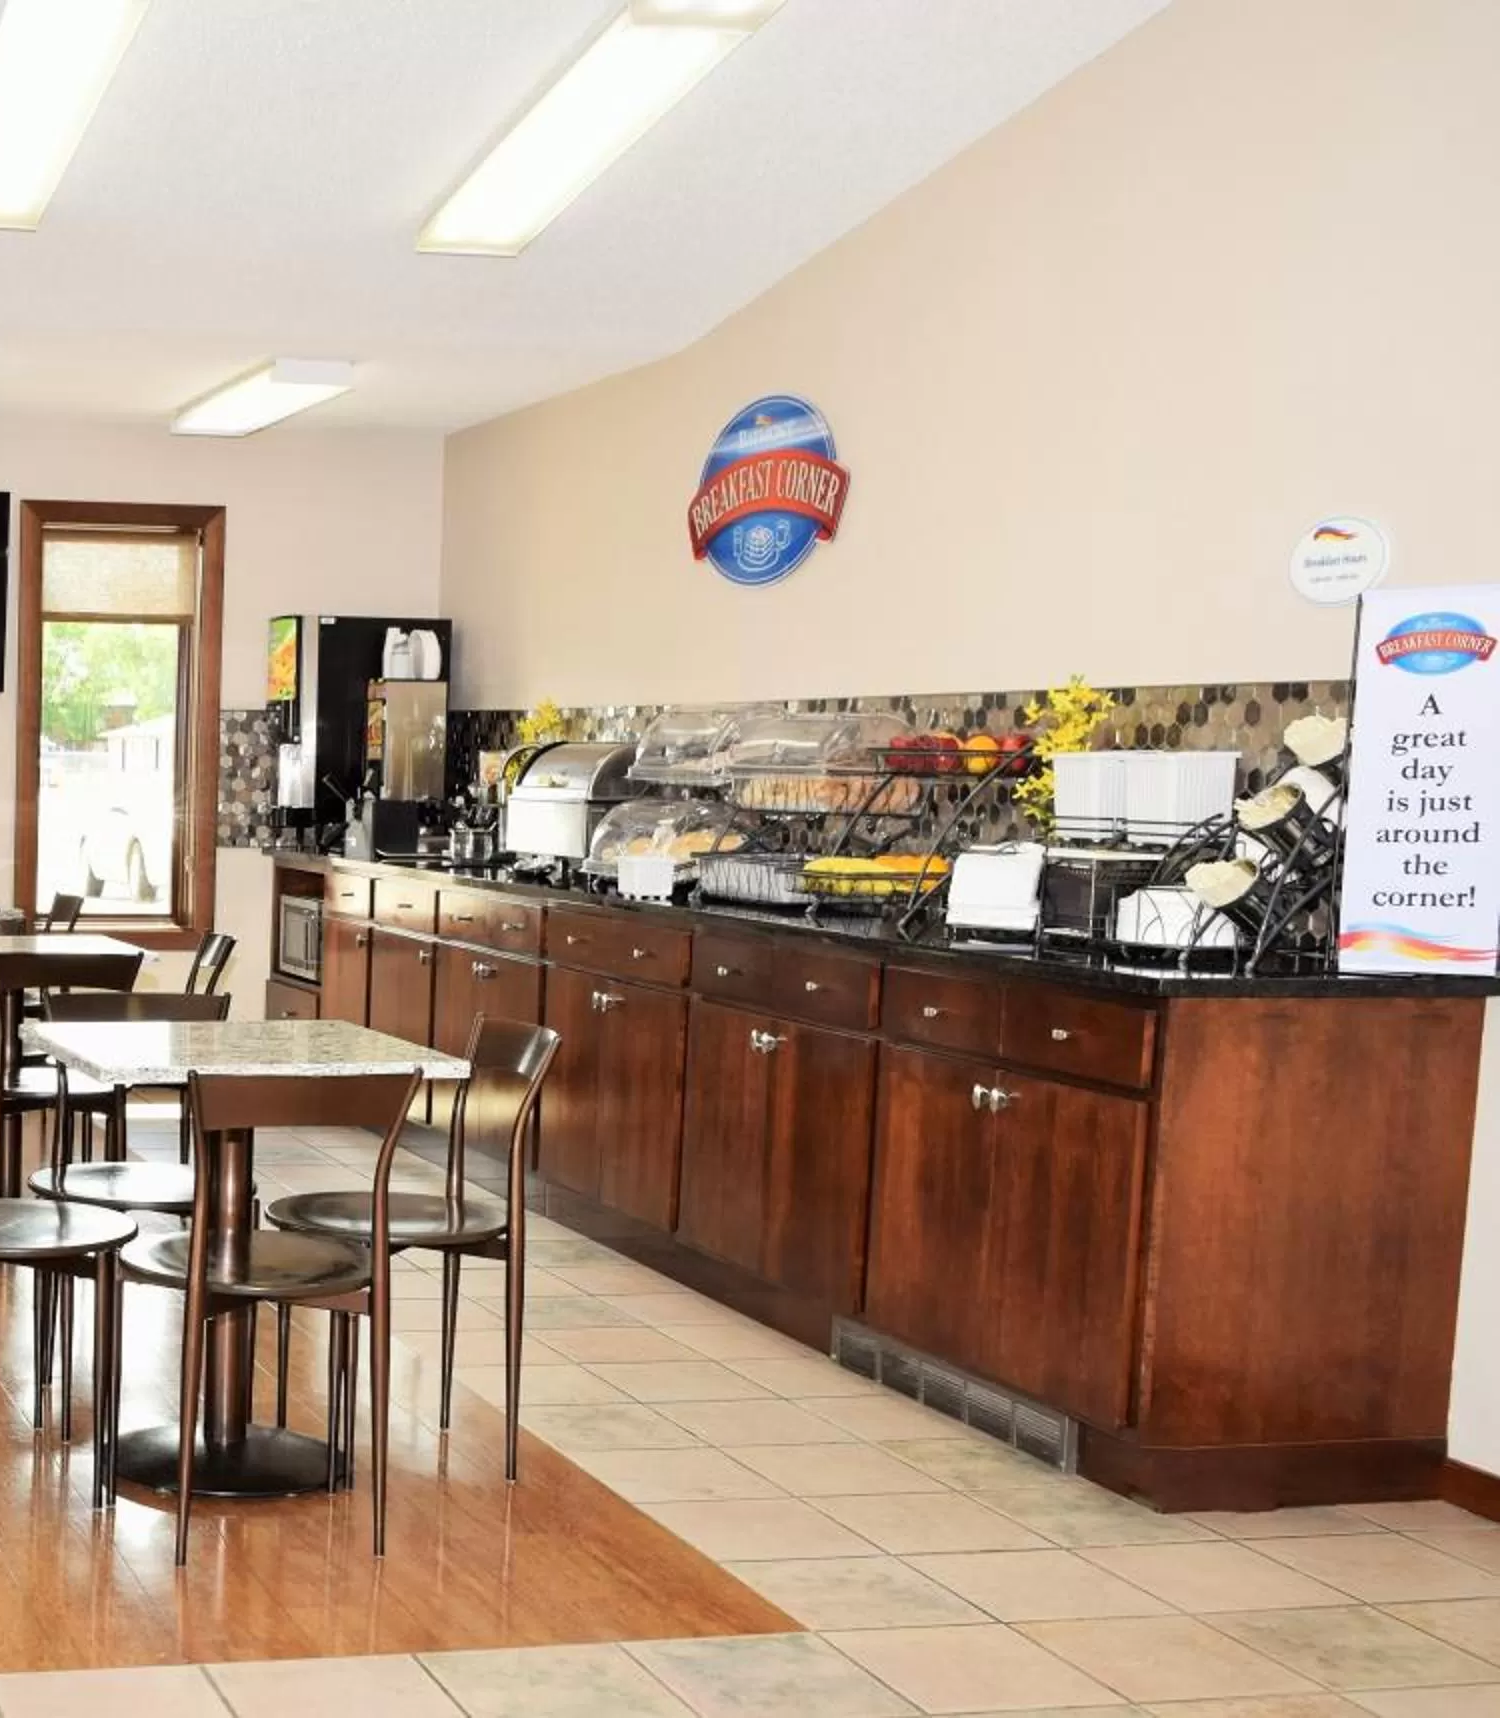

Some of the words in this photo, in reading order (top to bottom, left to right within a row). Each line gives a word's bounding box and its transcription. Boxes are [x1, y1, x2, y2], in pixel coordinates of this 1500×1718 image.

[692, 460, 774, 538] BREAKFAST
[777, 460, 840, 517] CORNER
[1380, 631, 1440, 656] BREAKFAST
[1444, 631, 1493, 652] CORNER
[1418, 693, 1442, 716] A
[1391, 730, 1468, 756] great
[1401, 757, 1454, 787] day
[1387, 789, 1410, 812] is
[1419, 789, 1473, 818] just
[1376, 821, 1480, 844] around
[1402, 853, 1449, 876] the
[1372, 885, 1476, 908] corner!
